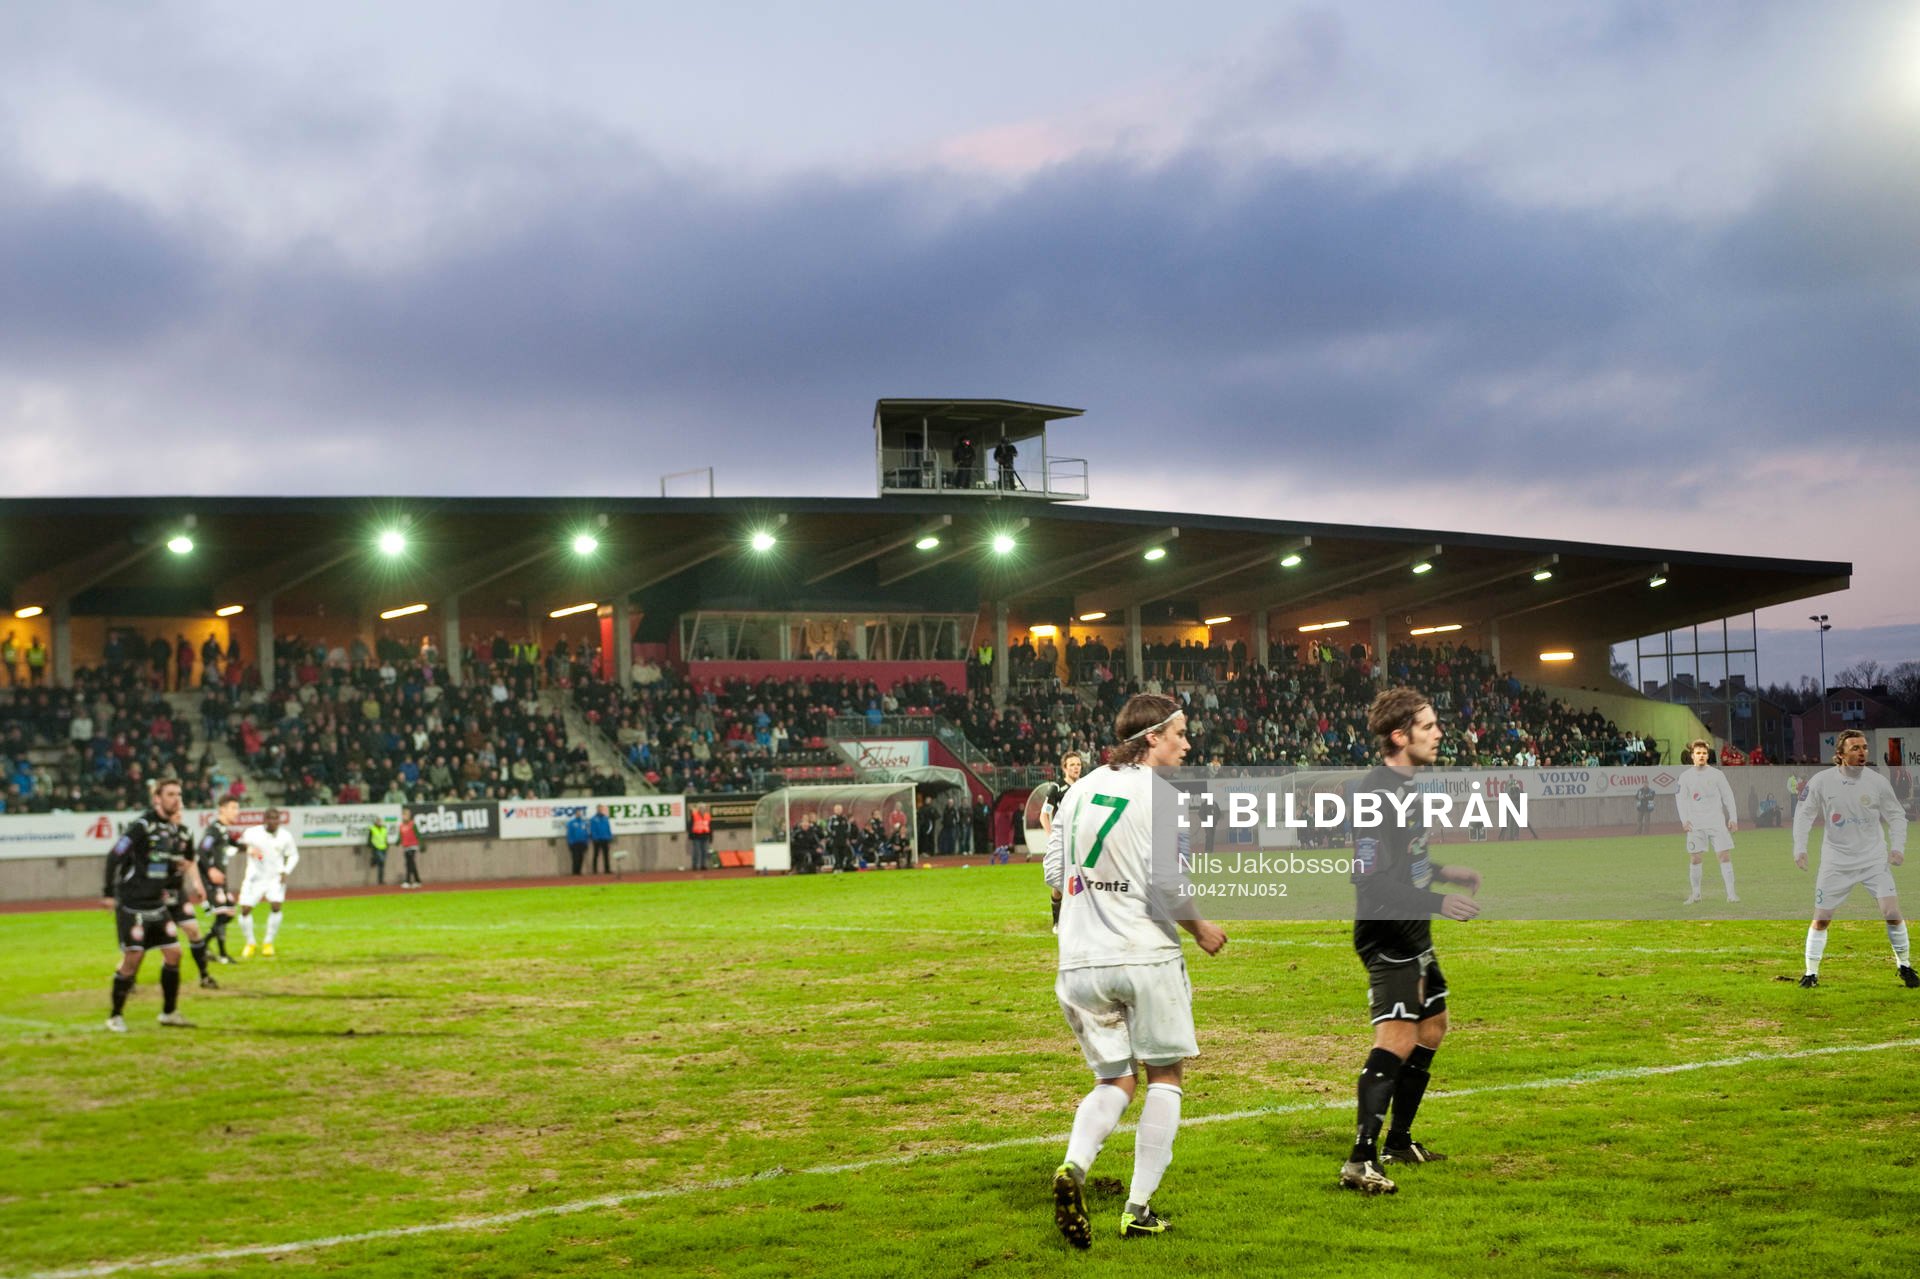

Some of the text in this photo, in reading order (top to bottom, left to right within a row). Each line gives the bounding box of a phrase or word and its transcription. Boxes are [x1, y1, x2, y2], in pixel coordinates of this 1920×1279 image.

[1537, 771, 1590, 784] VOLVO
[1609, 774, 1649, 787] Canon
[1542, 783, 1587, 796] AERO
[515, 805, 588, 819] INTERSPORT
[608, 803, 672, 819] PEAB
[414, 805, 489, 834] cela.nu
